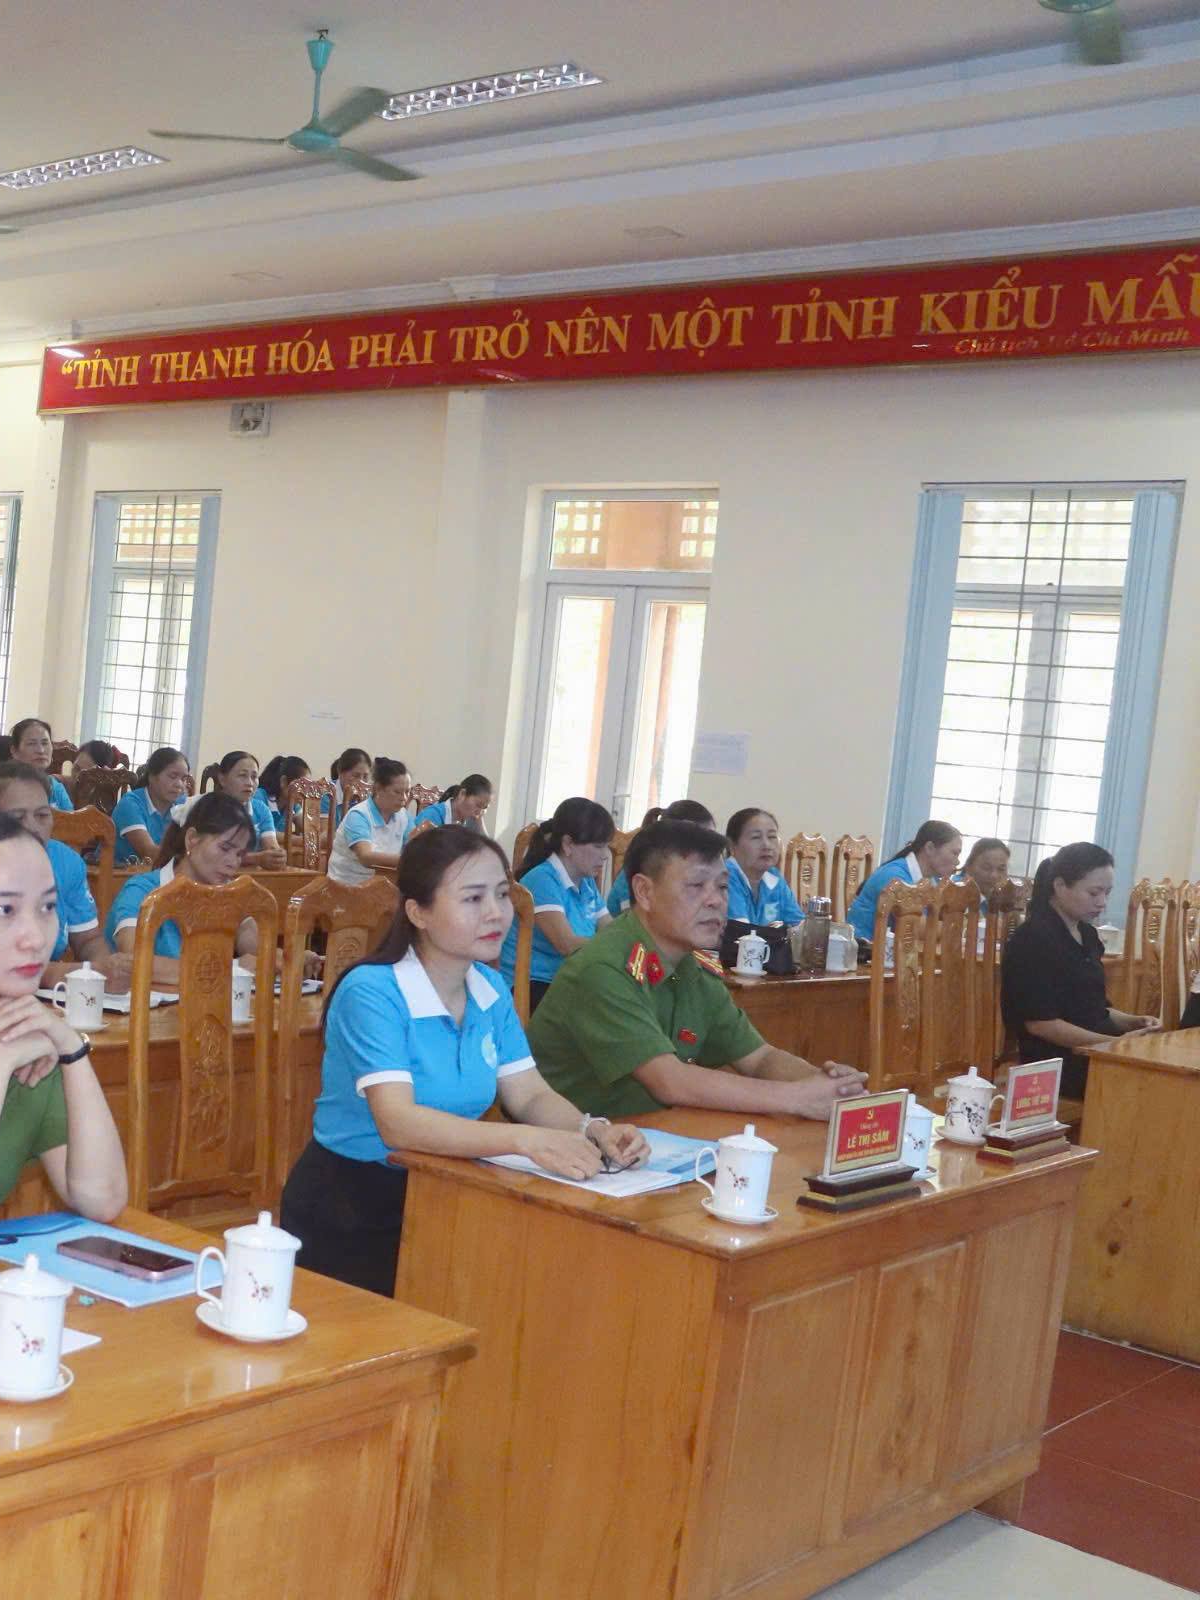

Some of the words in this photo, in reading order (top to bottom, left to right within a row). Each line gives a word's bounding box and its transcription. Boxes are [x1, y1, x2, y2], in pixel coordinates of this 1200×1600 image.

[62, 349, 139, 390] “TỈNH
[151, 345, 256, 384] THANH
[267, 329, 334, 375] HÓA
[348, 320, 435, 369] PHẢI
[449, 309, 530, 362] TRỞ
[544, 307, 632, 357] NÊN
[648, 298, 753, 357] MỘT
[772, 288, 899, 344] TỈNH
[919, 267, 1062, 335] KIỂU
